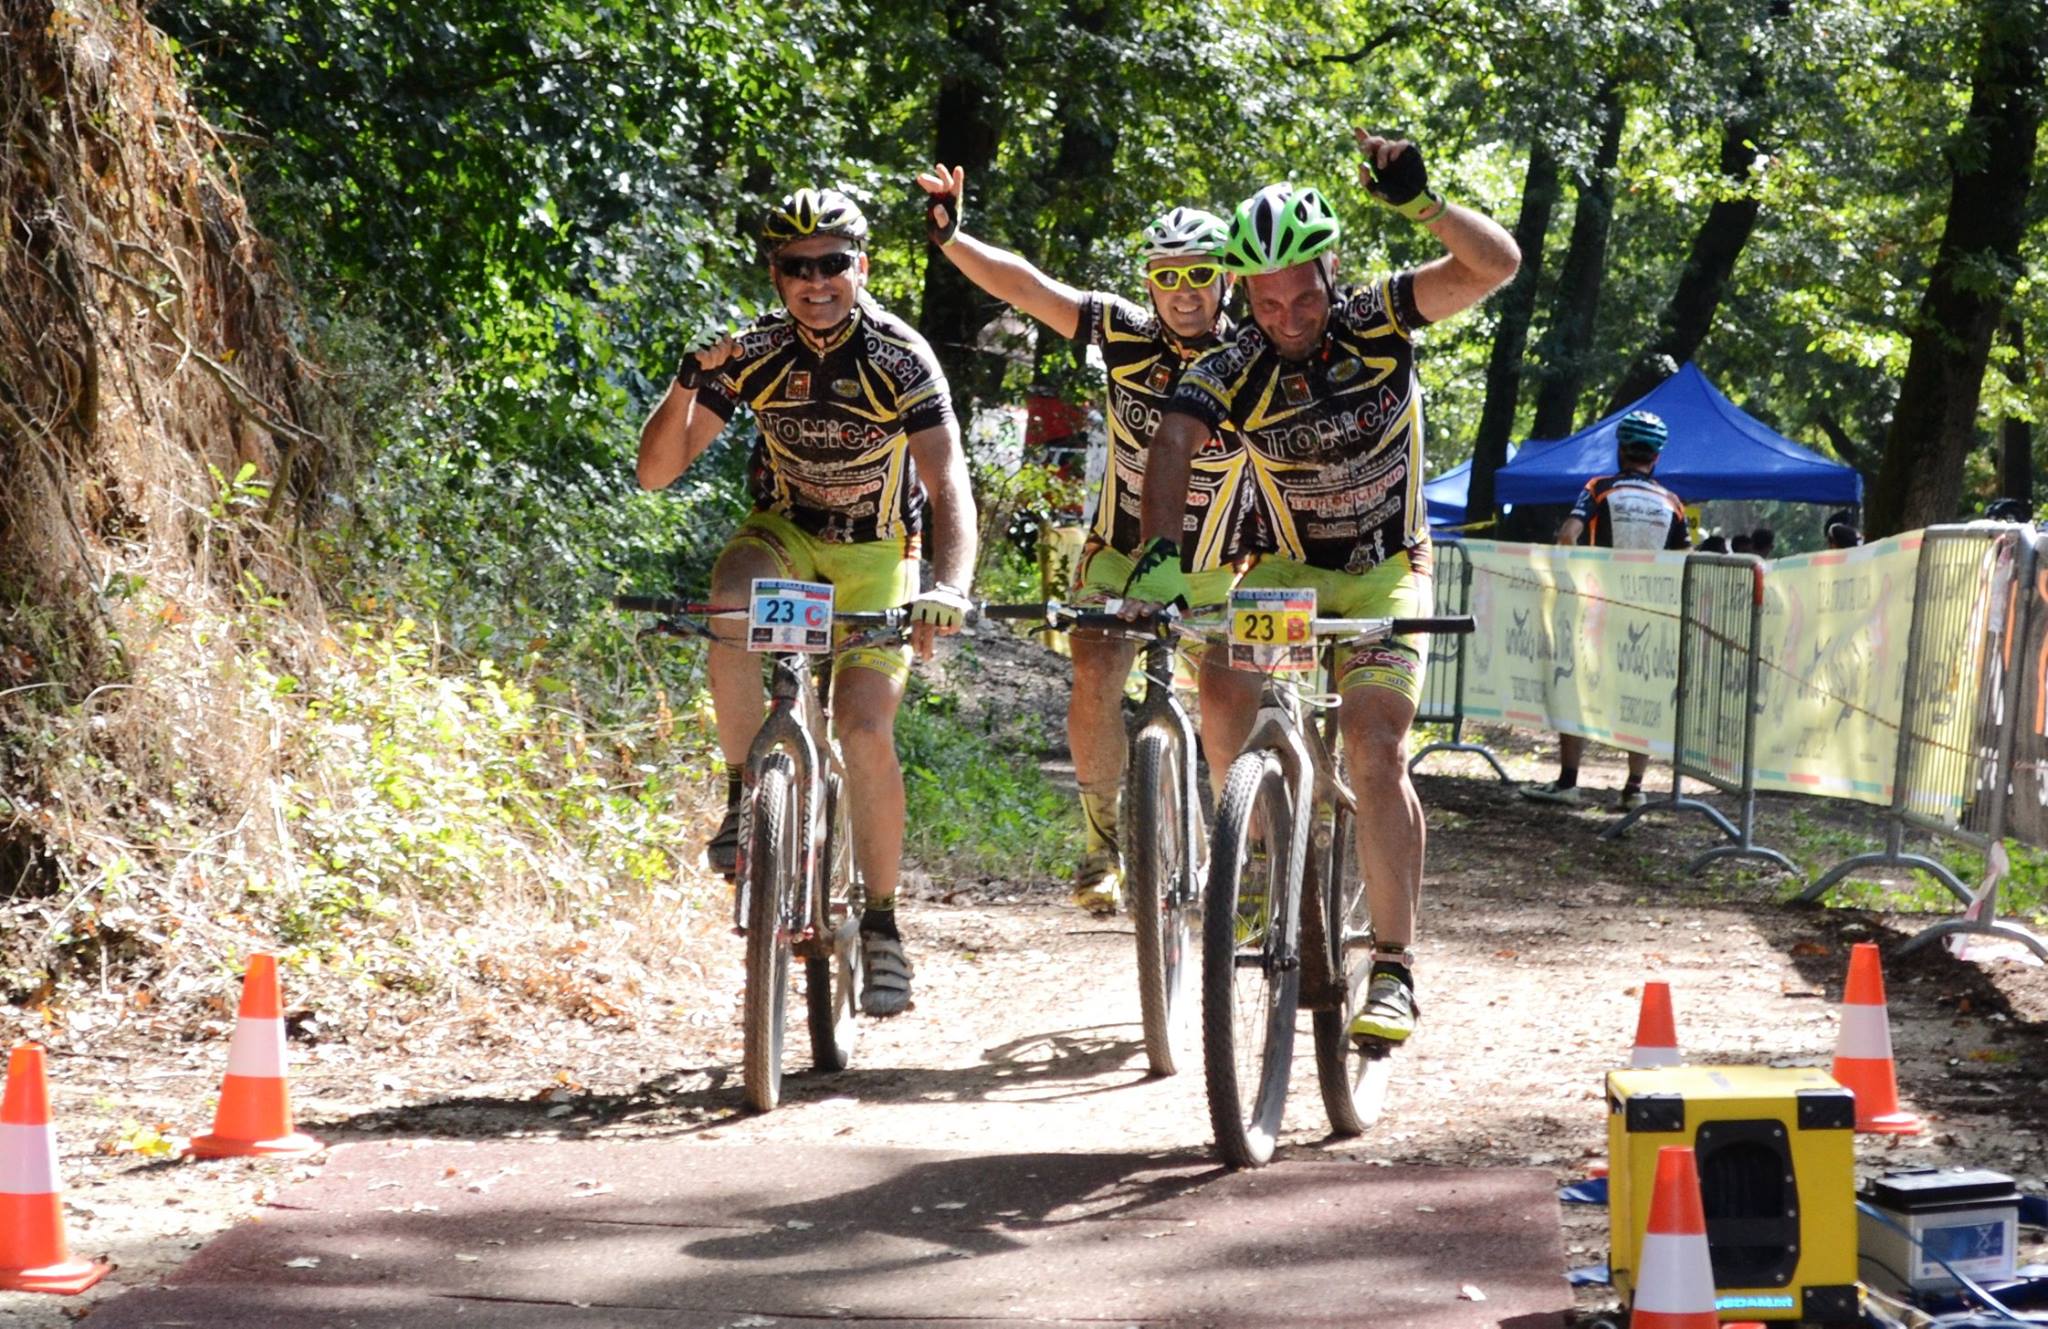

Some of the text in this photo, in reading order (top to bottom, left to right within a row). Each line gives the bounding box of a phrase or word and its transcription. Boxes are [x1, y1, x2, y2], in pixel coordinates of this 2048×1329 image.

[765, 599, 824, 627] 23 C
[1244, 614, 1307, 642] 23 B
